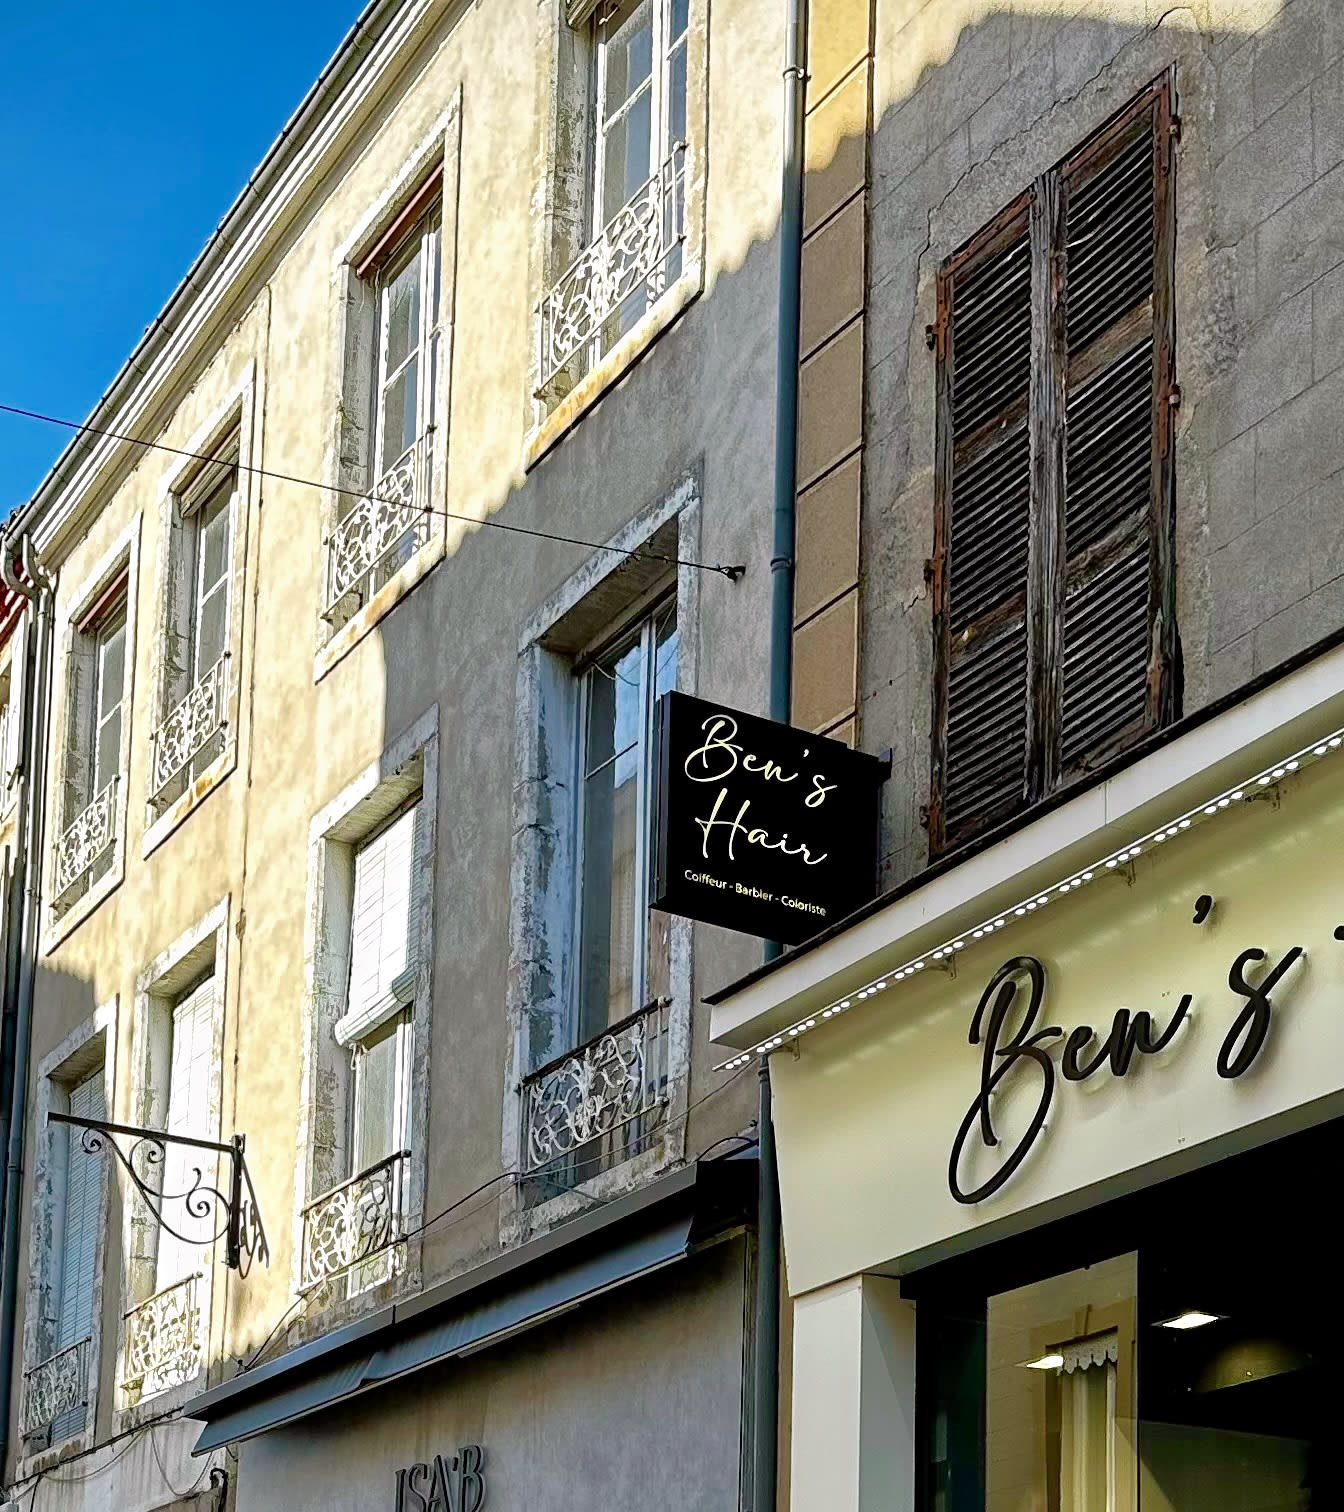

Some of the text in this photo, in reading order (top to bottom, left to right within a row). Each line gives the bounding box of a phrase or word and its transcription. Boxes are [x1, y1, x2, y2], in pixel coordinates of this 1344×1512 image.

[684, 714, 838, 808] Ben's
[694, 787, 828, 865] Hair
[684, 870, 728, 889] Coiffeur
[736, 883, 773, 901] Barbier
[781, 896, 826, 916] Coloriste
[947, 894, 1308, 1205] Ben's
